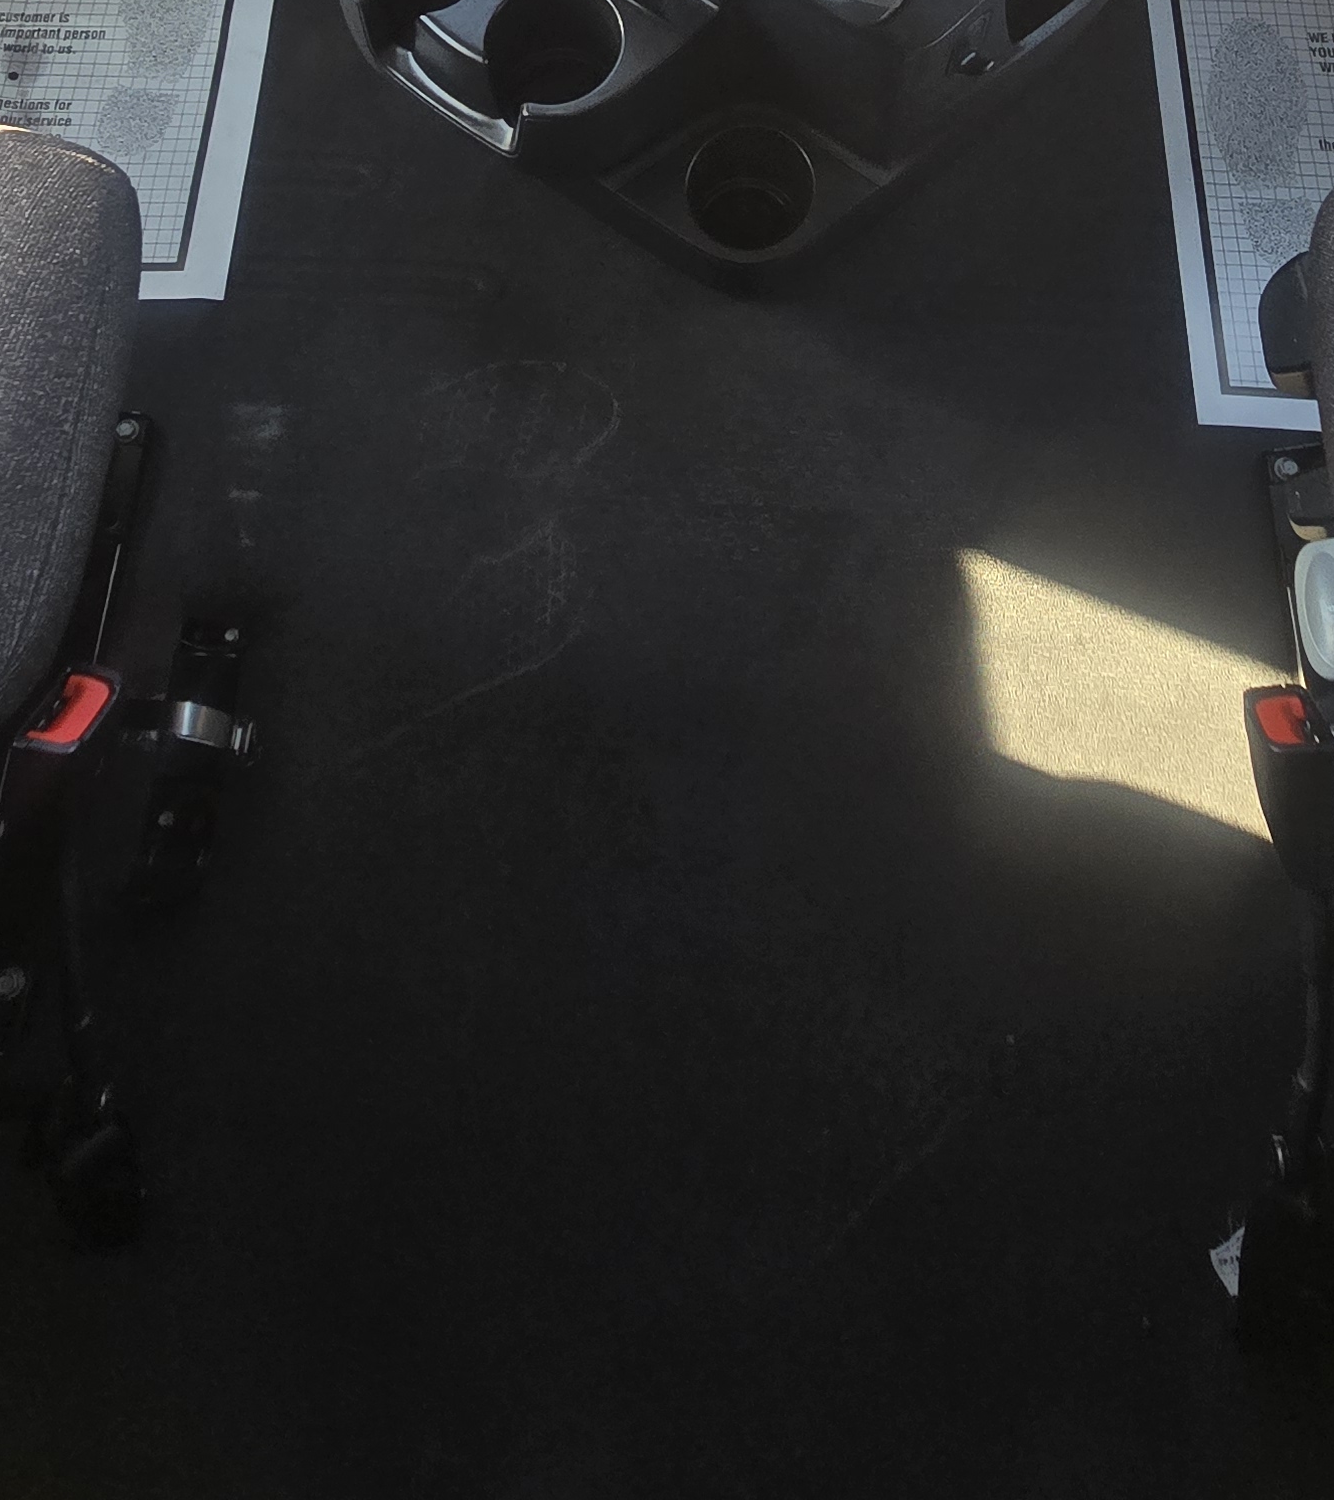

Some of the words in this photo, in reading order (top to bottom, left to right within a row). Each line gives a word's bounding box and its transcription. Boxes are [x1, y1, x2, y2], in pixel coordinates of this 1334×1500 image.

[58, 11, 70, 23] is
[0, 27, 61, 41] important
[63, 29, 106, 41] person
[1308, 32, 1329, 43] WE
[3, 42, 39, 53] world
[42, 44, 55, 54] to
[54, 99, 72, 111] for
[24, 114, 72, 127] service
